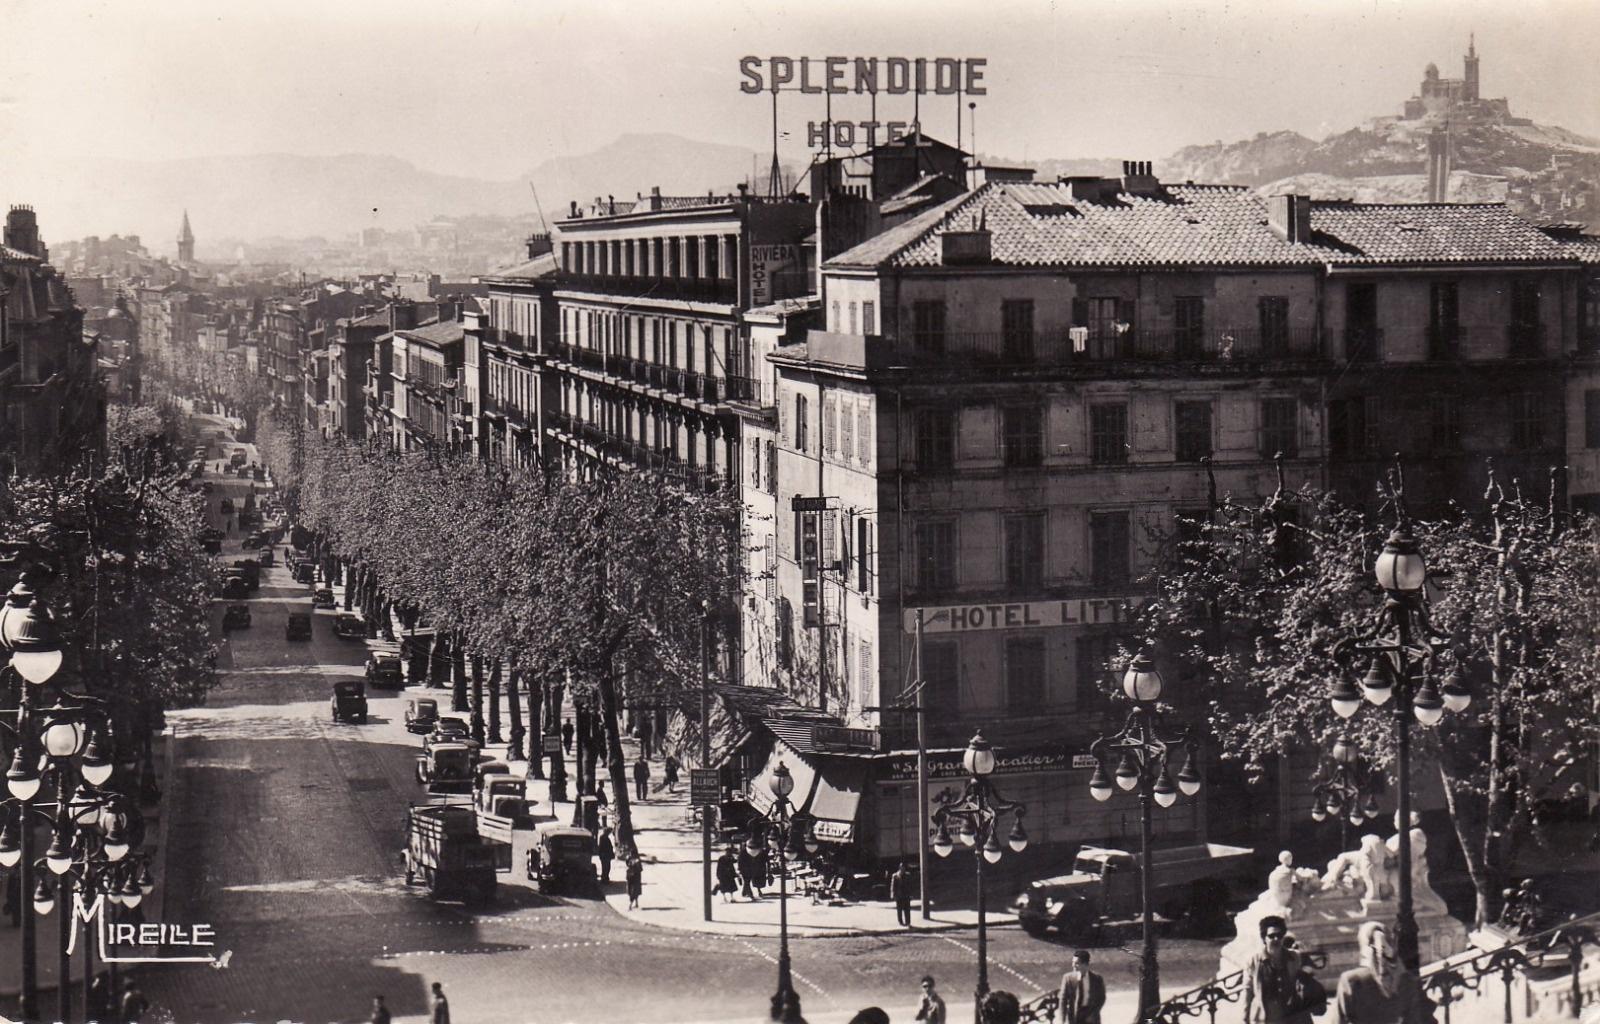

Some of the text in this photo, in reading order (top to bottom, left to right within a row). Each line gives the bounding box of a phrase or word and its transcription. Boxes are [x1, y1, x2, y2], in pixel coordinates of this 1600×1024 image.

[740, 56, 987, 95] SPLENDIDE
[807, 121, 932, 148] HOTEL
[751, 246, 796, 261] RIVIERA
[752, 262, 766, 305] HOTEL
[801, 514, 817, 626] HOTEL
[951, 599, 1129, 630] HOTEL LITT
